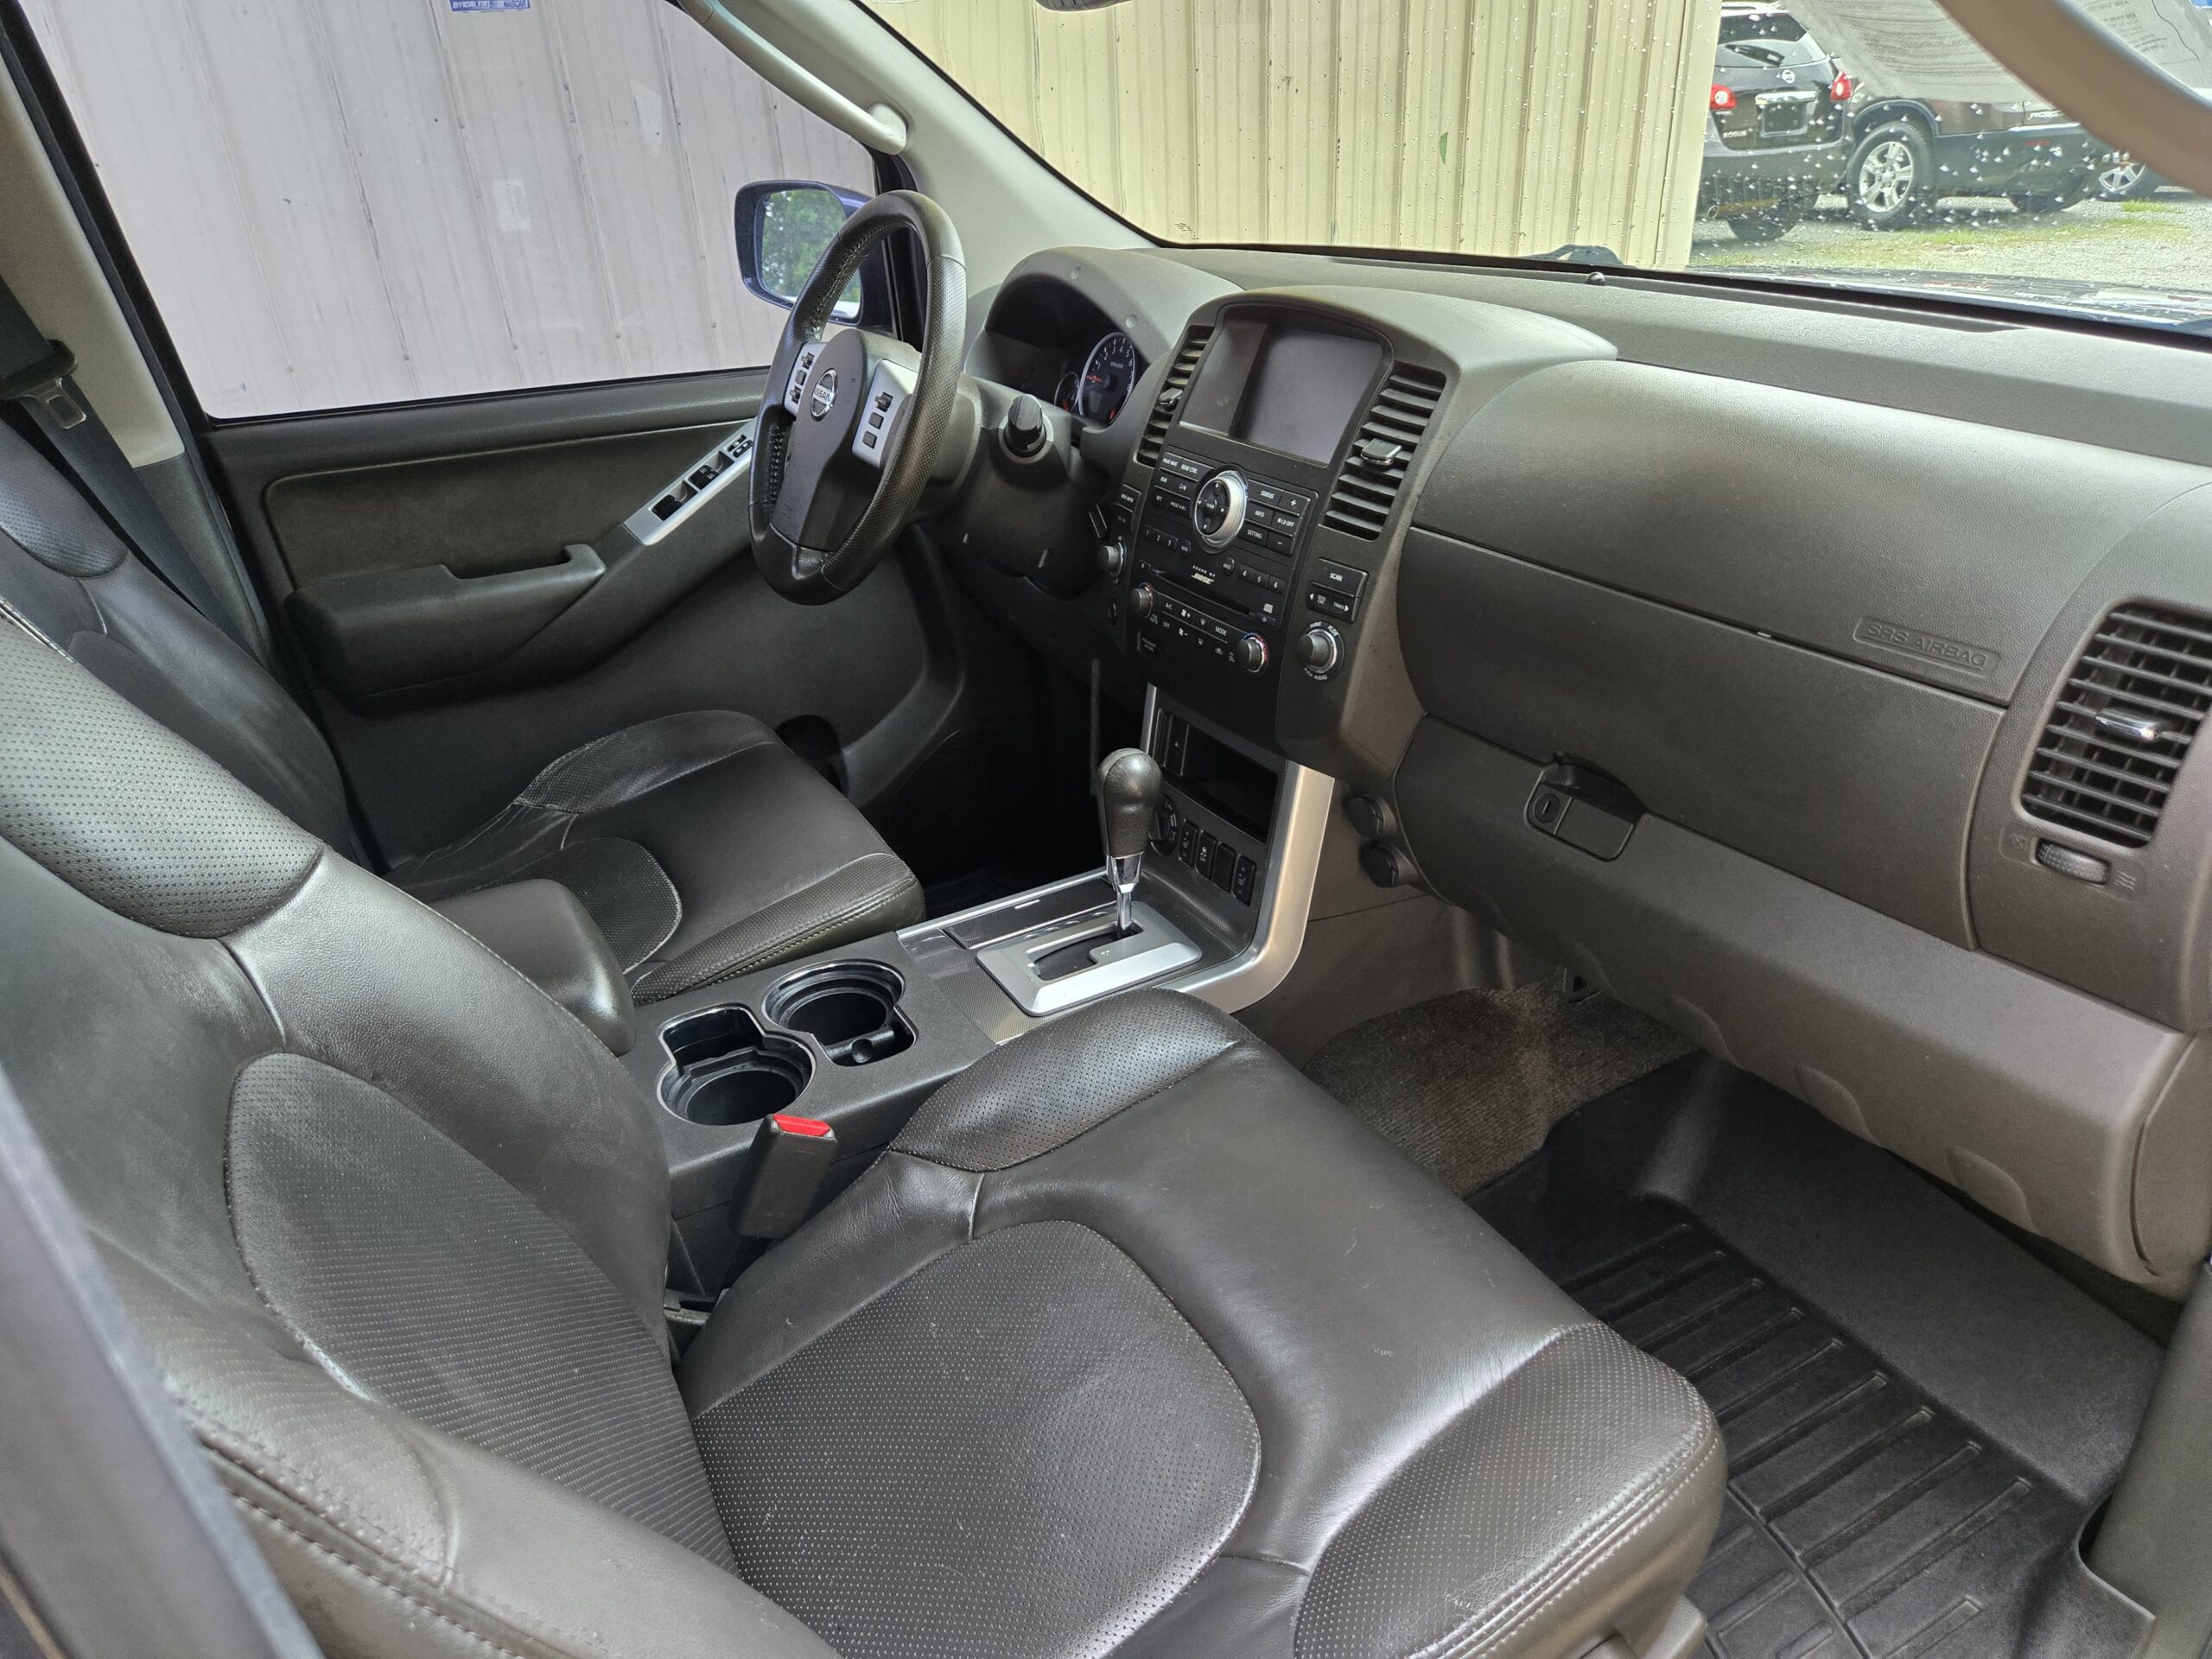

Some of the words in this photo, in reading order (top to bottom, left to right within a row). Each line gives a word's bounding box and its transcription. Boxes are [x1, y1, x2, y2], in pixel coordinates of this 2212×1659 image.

[1255, 510, 1265, 518] INFO
[1247, 529, 1262, 540] SETTING
[1191, 574, 1215, 585] BOSE
[1329, 572, 1344, 582] SCAN
[1165, 602, 1173, 611] A/C
[1162, 620, 1171, 629] OFF
[1215, 626, 1228, 637] MODE
[1867, 624, 1909, 644] SRS
[1913, 636, 1989, 671] AIRBAG
